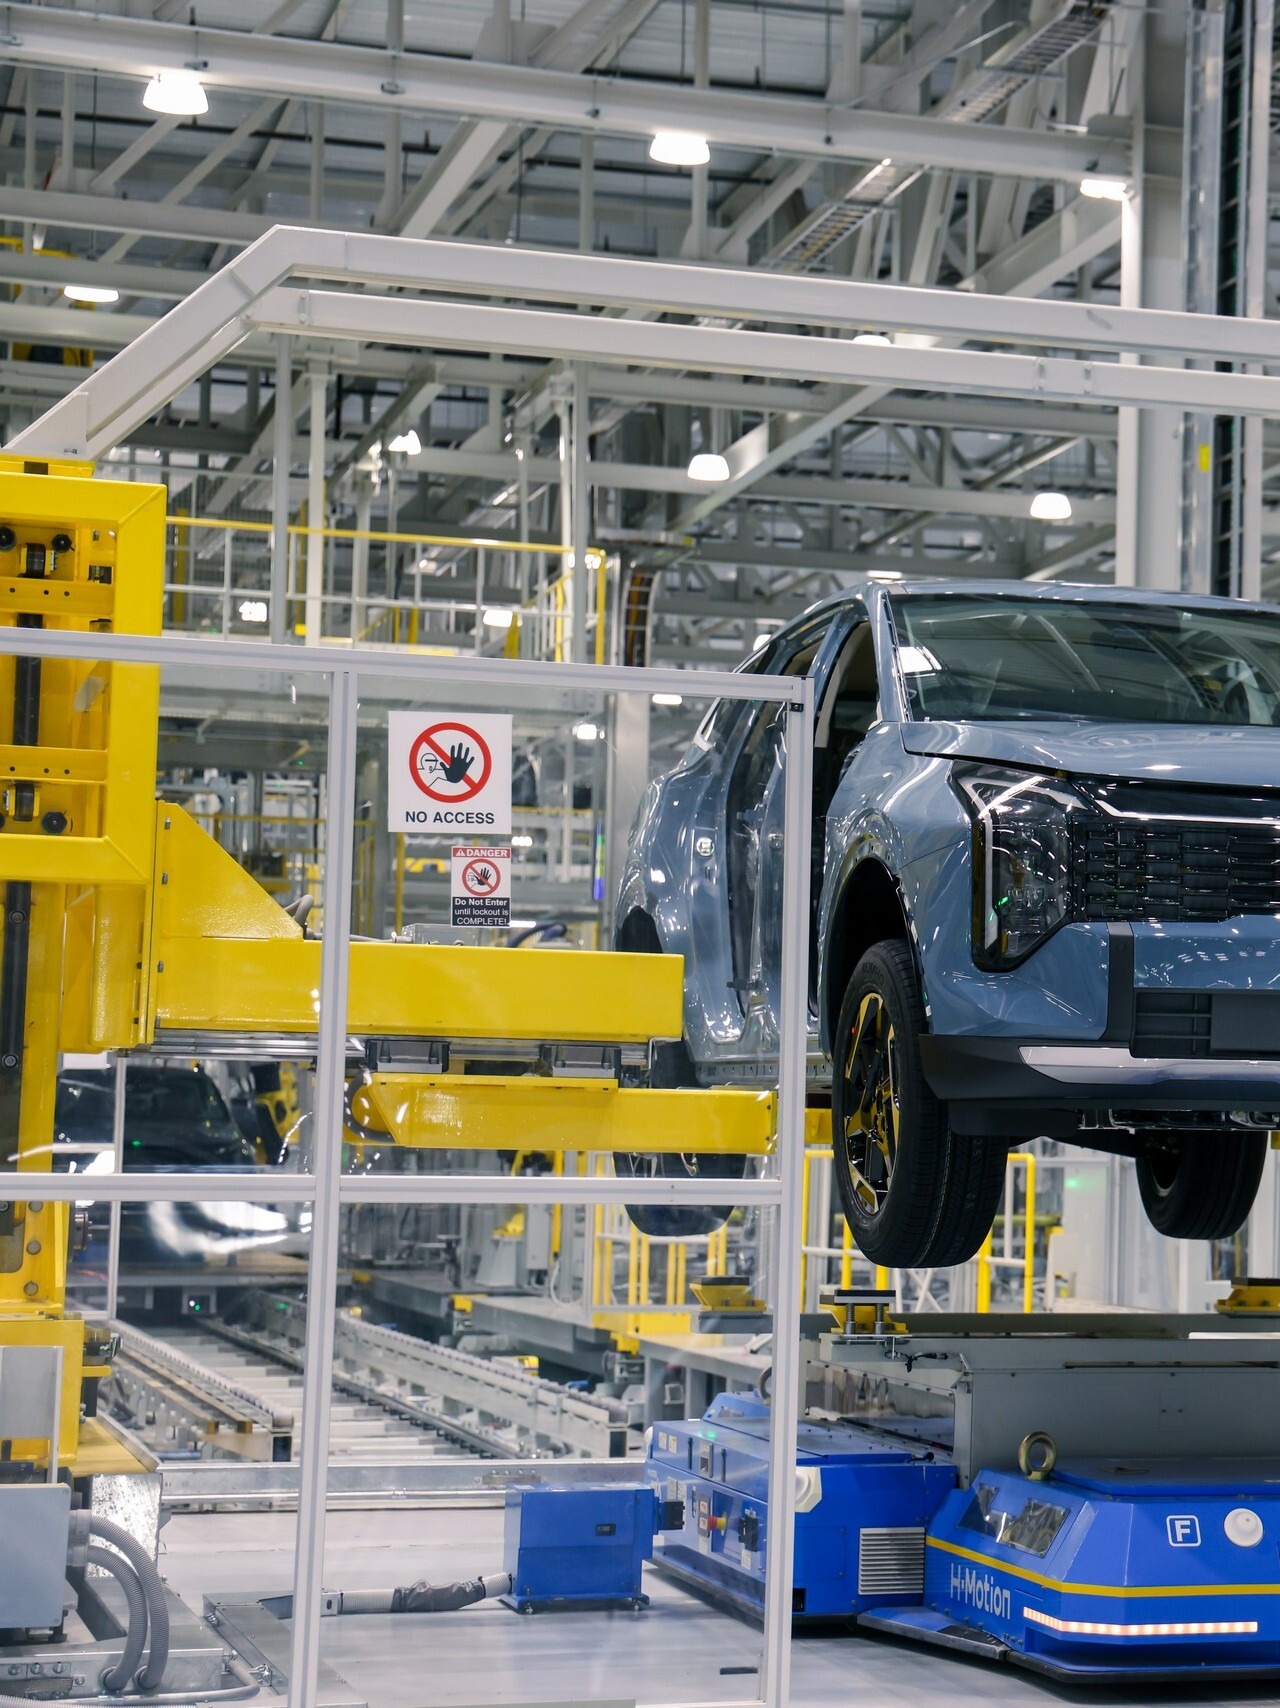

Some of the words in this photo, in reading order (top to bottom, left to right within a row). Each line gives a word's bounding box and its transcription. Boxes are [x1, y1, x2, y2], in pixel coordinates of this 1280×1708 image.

[405, 811, 427, 823] NO
[433, 812, 495, 824] ACCESS
[466, 849, 508, 857] DANGER
[456, 917, 507, 925] COMPLETE!
[1174, 1520, 1191, 1540] F
